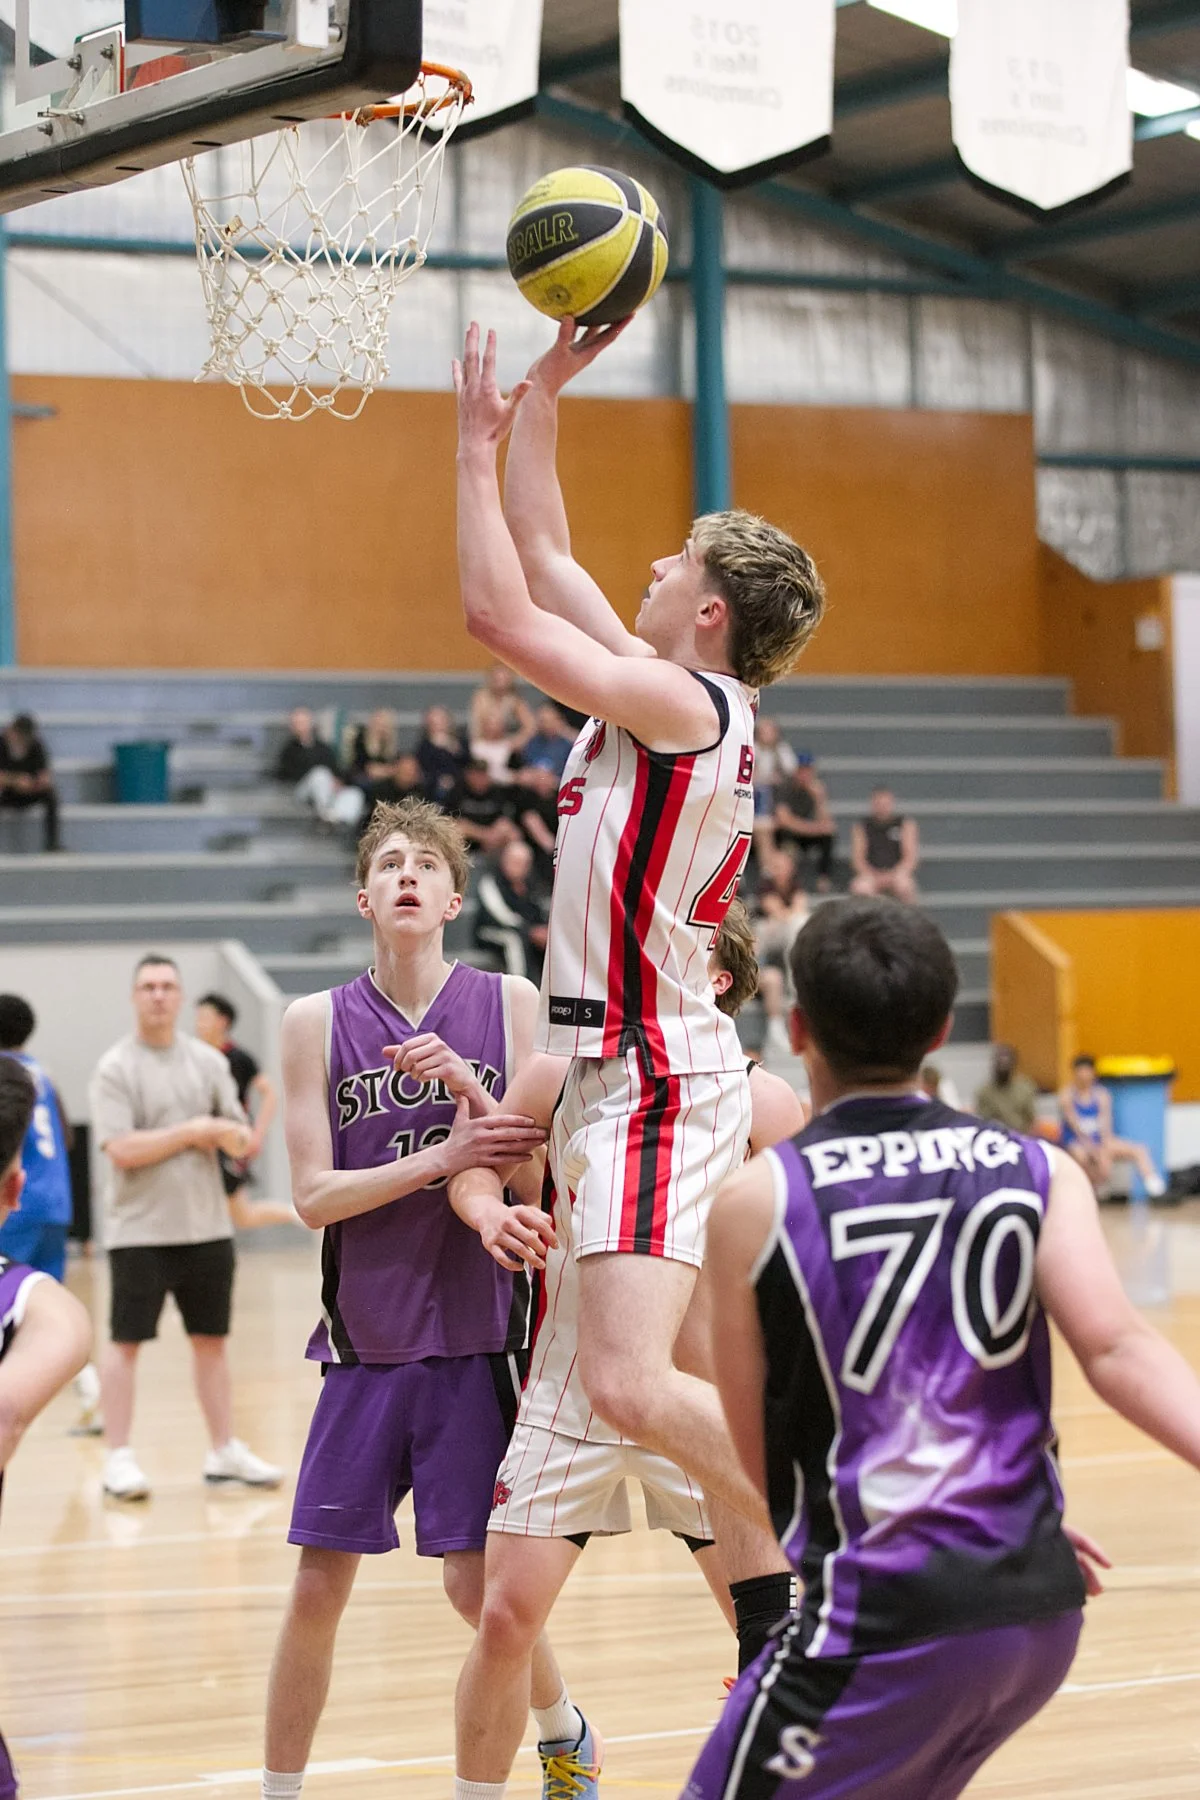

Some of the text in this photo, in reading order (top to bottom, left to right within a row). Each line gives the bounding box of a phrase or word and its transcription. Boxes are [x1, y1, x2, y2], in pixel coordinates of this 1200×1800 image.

[584, 1007, 593, 1019] S
[800, 1125, 1023, 1190] EPPING
[829, 1186, 1044, 1396] 70
[763, 1724, 829, 1780] S
